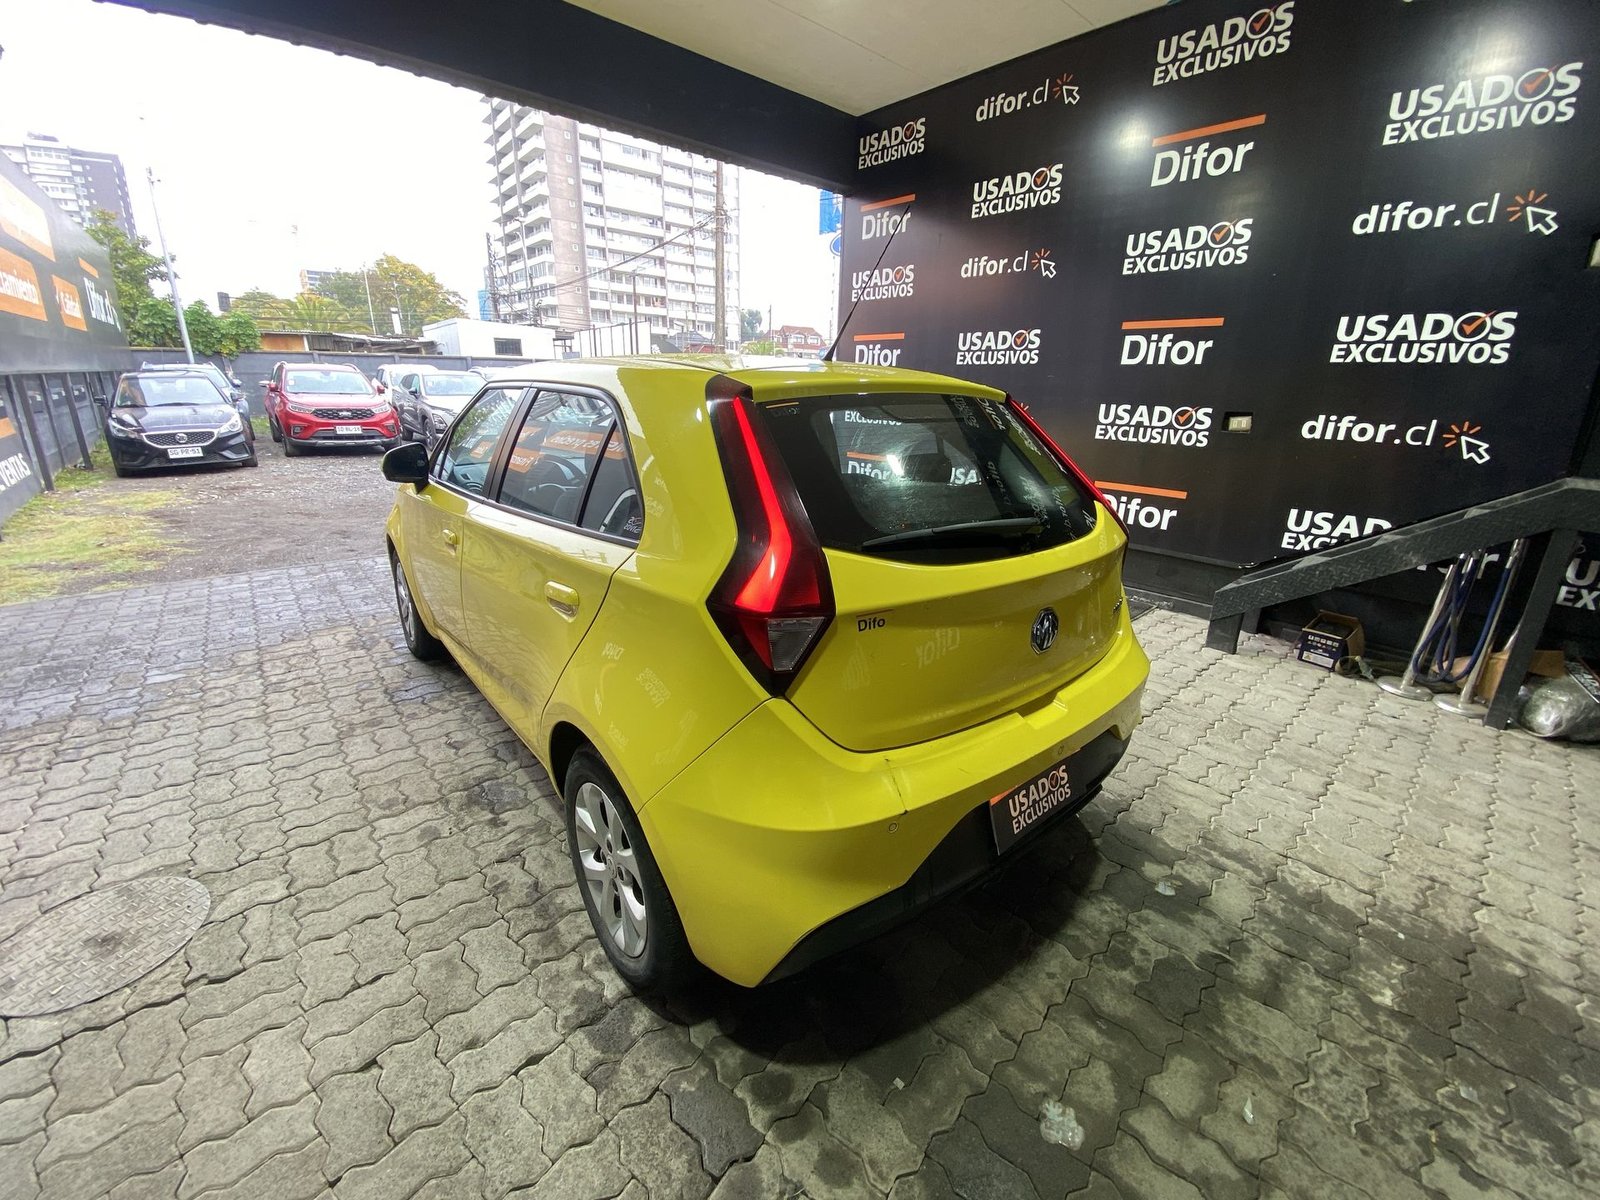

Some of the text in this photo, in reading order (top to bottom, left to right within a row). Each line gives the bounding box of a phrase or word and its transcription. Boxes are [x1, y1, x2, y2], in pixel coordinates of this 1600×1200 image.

[1156, 1, 1295, 64] USADOS
[1153, 31, 1291, 86] EXCLUSIVOS
[975, 79, 1050, 122] difor.cl
[1389, 62, 1584, 120] USADOS
[859, 117, 926, 155] USADOS
[1382, 97, 1577, 146] EXCLUSIVOS
[858, 138, 925, 170] EXCLUSIVOS
[1151, 141, 1254, 187] Difor
[973, 164, 1063, 202] USADOS
[971, 187, 1061, 218] EXCLUSIVOS
[1352, 193, 1500, 235] difor.cl
[861, 211, 911, 240] Difor
[1126, 218, 1253, 256] USADOS
[960, 250, 1028, 278] difor.cl
[1122, 246, 1249, 275] EXCLUSIVOS
[852, 264, 915, 289] USADOS
[851, 283, 914, 302] EXCLUSIVOS
[958, 329, 1041, 351] USADOS
[1336, 311, 1518, 342] USADOS
[854, 344, 901, 367] Difor
[956, 347, 1039, 366] EXCLUSIVOS
[1120, 334, 1214, 365] Difor
[1330, 342, 1511, 365] EXCLUSIVOS
[1098, 404, 1213, 430] USADOS
[1301, 415, 1438, 446] difor.cl
[1094, 425, 1210, 447] EXCLUSIVOS
[857, 617, 886, 632] Difo
[1009, 765, 1068, 818] USADOS
[1012, 785, 1071, 834] EXCLUSIVOS
